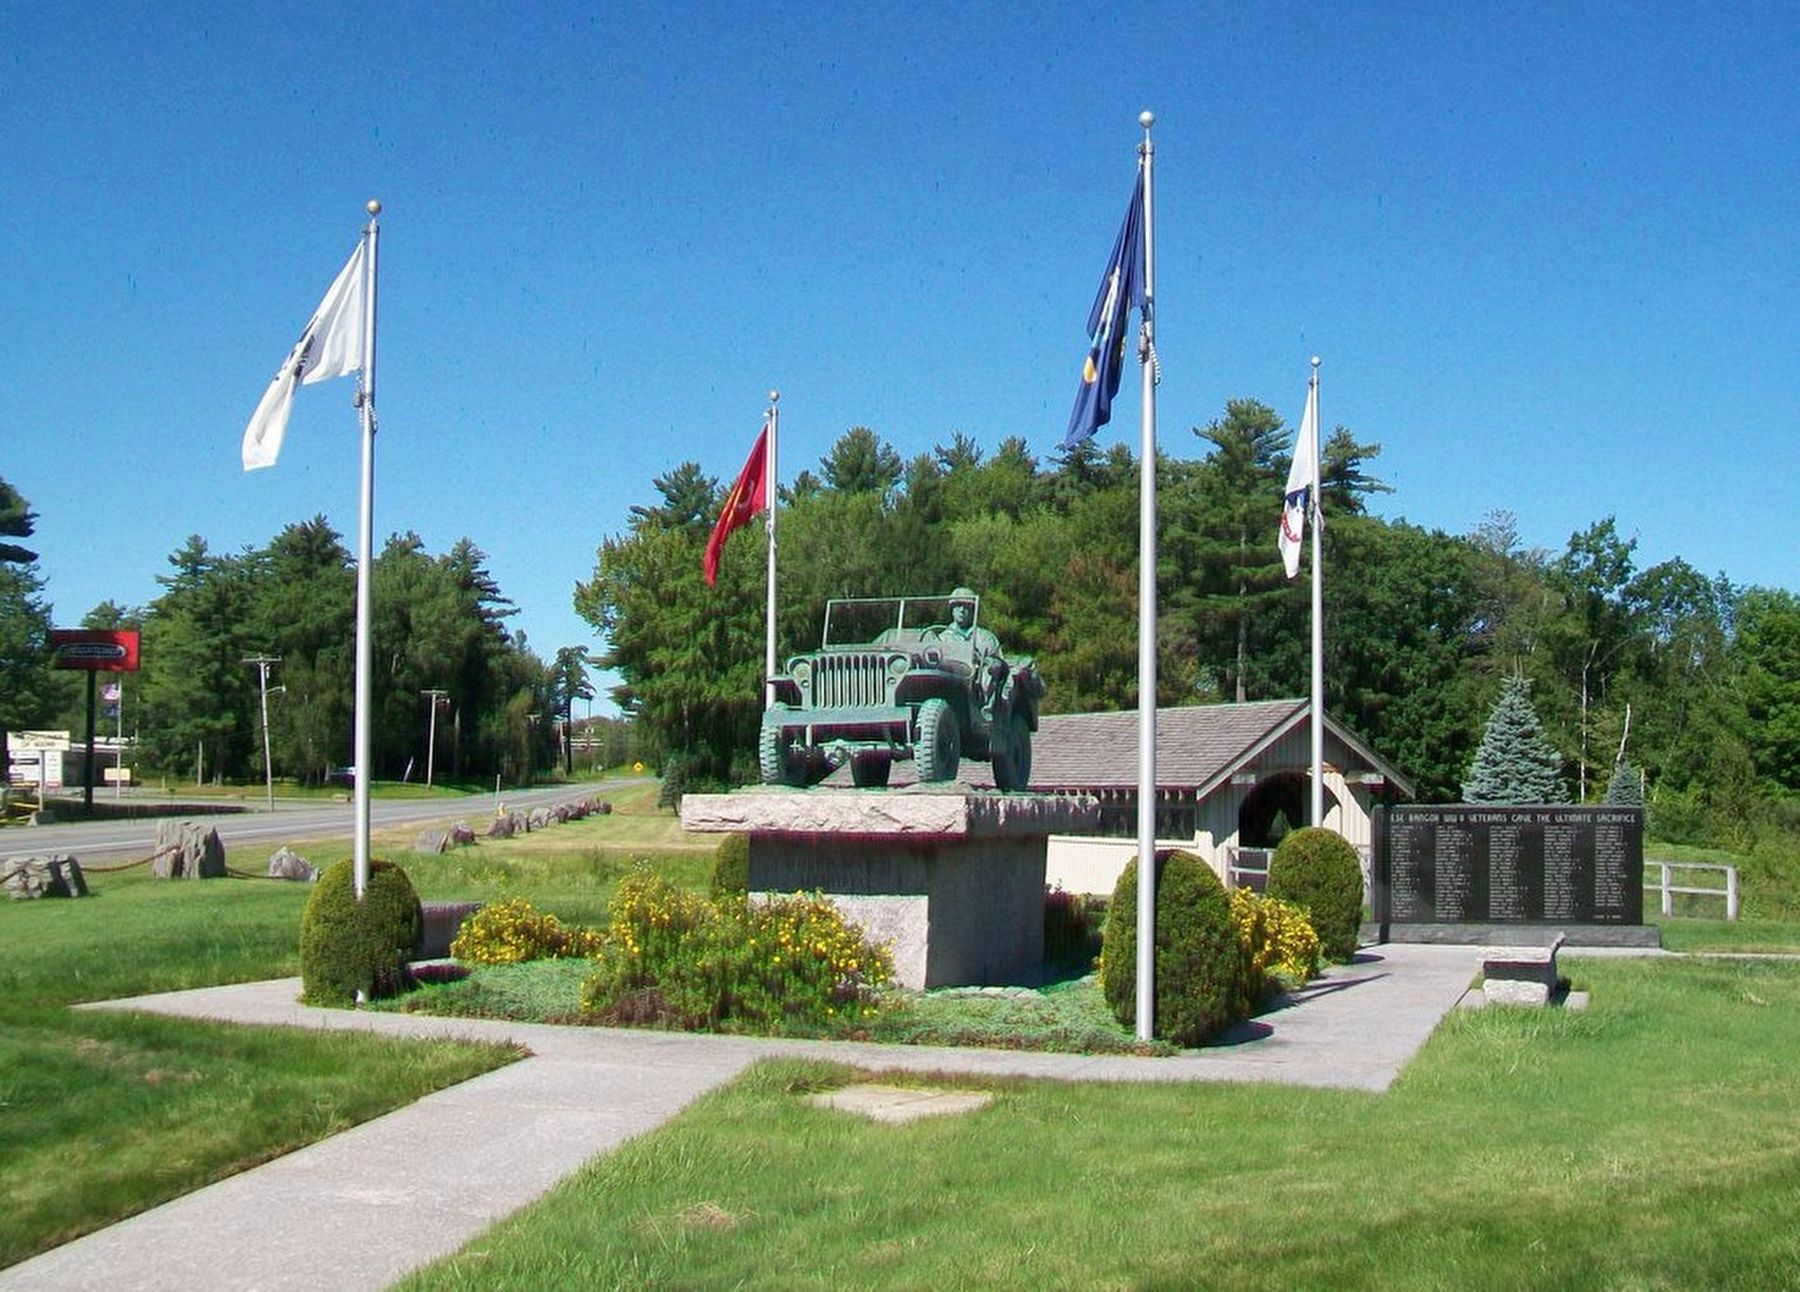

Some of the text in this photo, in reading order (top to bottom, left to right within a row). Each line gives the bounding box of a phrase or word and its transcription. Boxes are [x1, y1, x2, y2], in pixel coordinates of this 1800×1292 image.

[1468, 814, 1507, 823] VETERANS
[1536, 813, 1551, 823] THE
[1555, 813, 1592, 823] ULTIMATE
[1596, 813, 1636, 823] SACRIFICE
